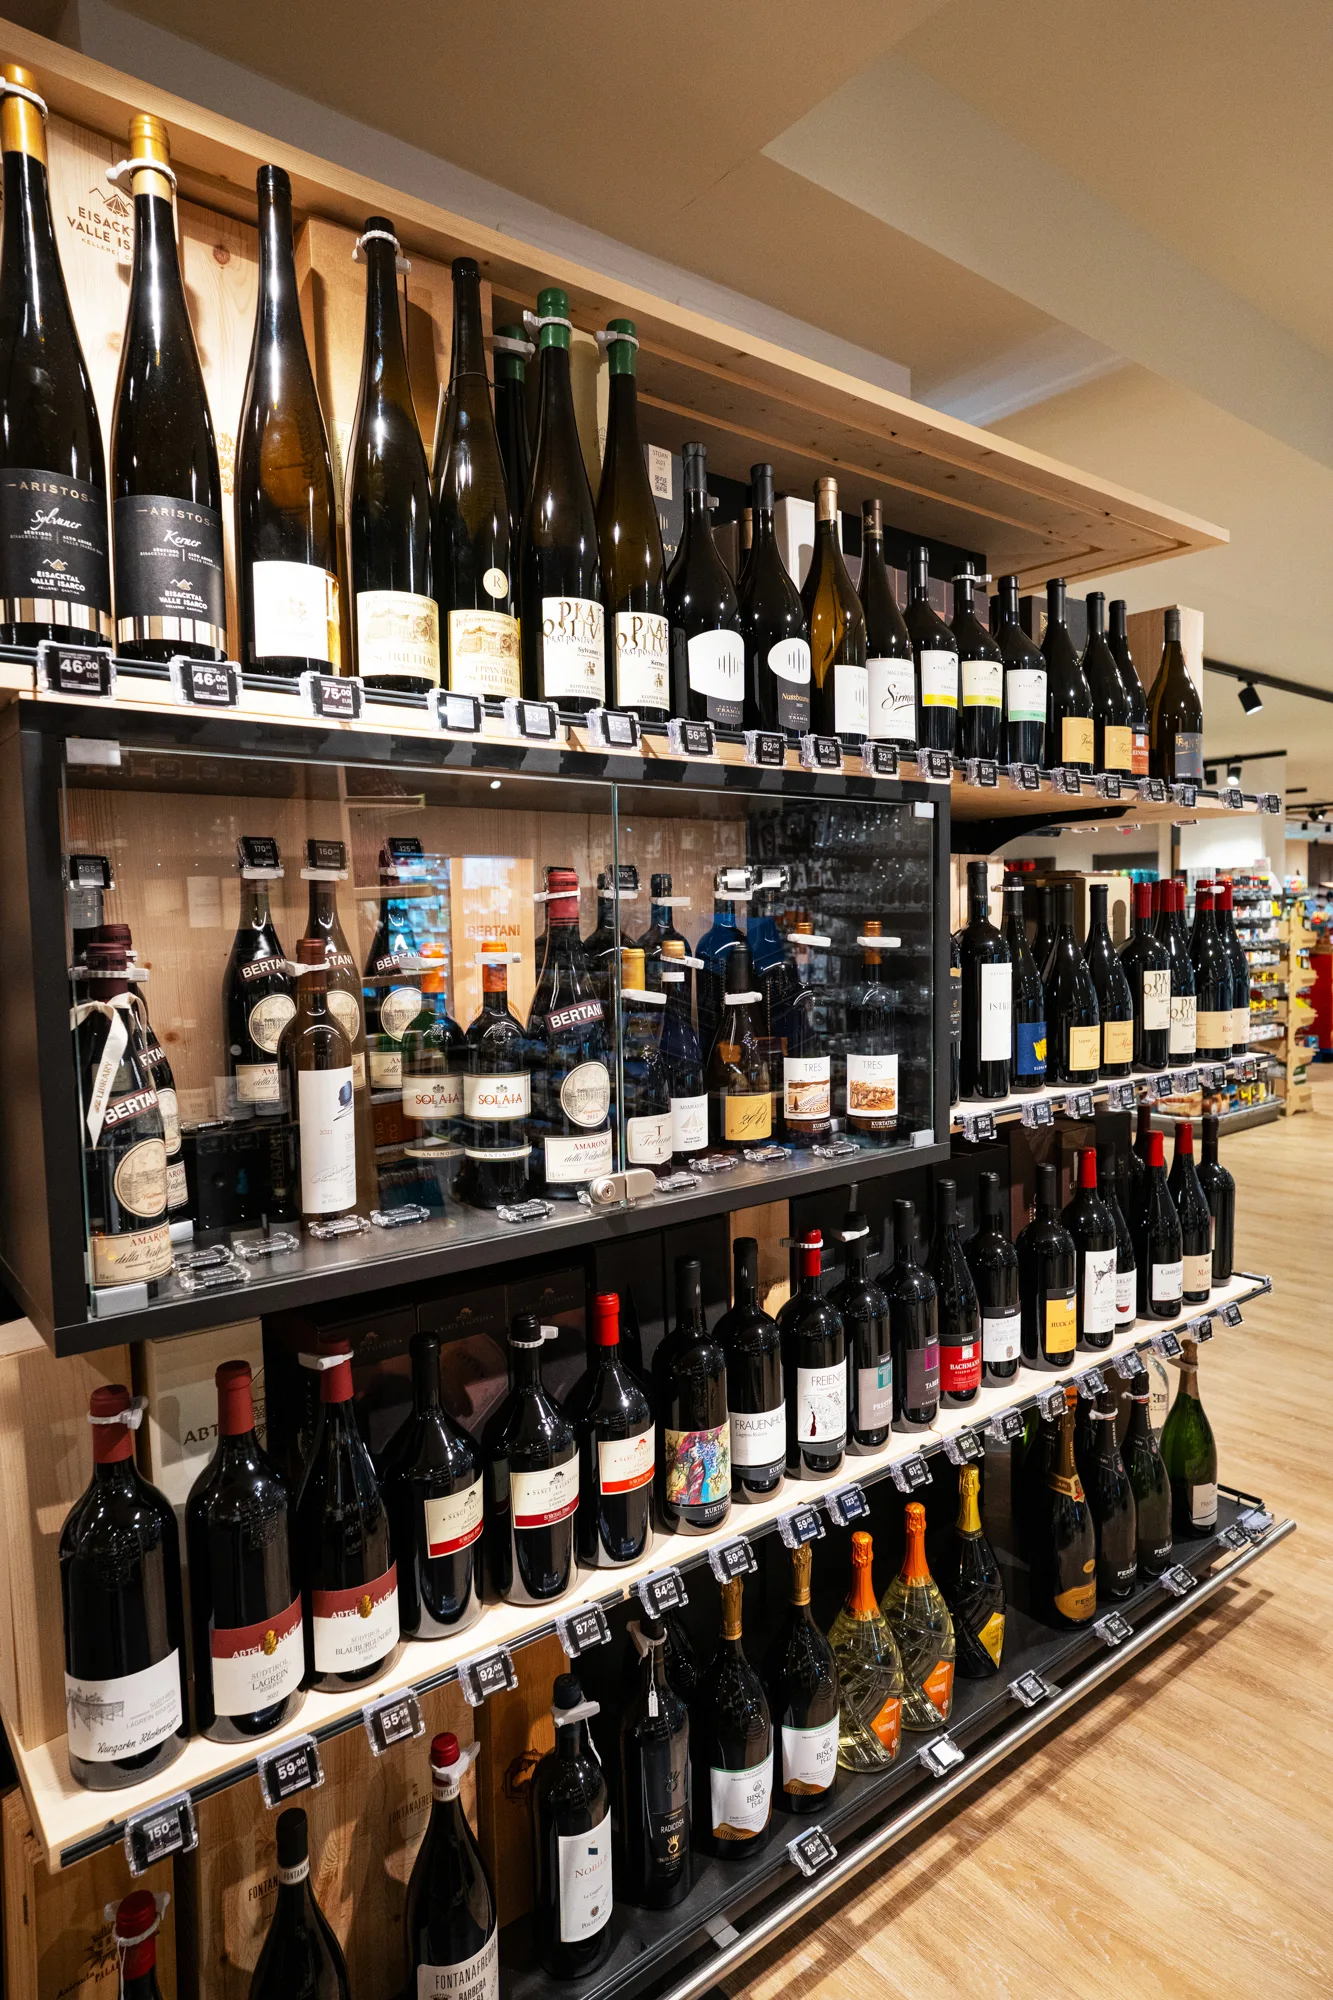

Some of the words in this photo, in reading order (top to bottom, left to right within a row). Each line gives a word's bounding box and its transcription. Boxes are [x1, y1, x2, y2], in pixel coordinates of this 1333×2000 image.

[78, 206, 135, 237] EISACK
[67, 216, 110, 243] VALLE
[117, 236, 131, 250] IS
[20, 481, 89, 502] ARISTOS
[150, 507, 210, 526] ARISTOS
[163, 529, 201, 548] Kerner
[30, 578, 54, 586] VALLE
[57, 580, 85, 591] ISARCO
[37, 570, 80, 583] EISACKTAL
[493, 575, 501, 588] R
[159, 596, 180, 605] VALLE
[183, 599, 208, 610] ISARCO
[165, 590, 203, 602] EISACKTAL
[578, 647, 599, 656] Sylvaner
[60, 659, 98, 673] 46,00
[193, 672, 227, 685] 46,00
[322, 686, 350, 700] 75,00
[466, 925, 521, 937] BERTANI
[242, 959, 286, 979] BERTA
[804, 1063, 823, 1072] TRES
[863, 1060, 883, 1070] TRES
[97, 1061, 113, 1099] LIBRARY
[104, 1090, 158, 1125] BERTAN
[415, 1093, 460, 1105] SOLAIA
[479, 1093, 522, 1105] SOLAIA
[573, 1139, 608, 1151] AMARONE
[130, 1228, 169, 1247] AMARON
[755, 1275, 787, 1289] TATSCH
[811, 1369, 845, 1387] FREIENF
[735, 1416, 784, 1430] FRAUENHÜ
[184, 1424, 219, 1446] ABT
[704, 1500, 730, 1516] KURTATS
[1117, 1563, 1137, 1577] FERRA
[654, 1582, 674, 1599] 84,00
[331, 1606, 358, 1620] ABTEI
[351, 1627, 380, 1644] SÜDTIROL
[575, 1618, 596, 1636] 87,00
[335, 1626, 393, 1656] BLAUBURGUNDER
[232, 1643, 261, 1659] ABTEI
[251, 1658, 289, 1681] SÜDTIROL
[480, 1662, 502, 1682] 92,00
[252, 1668, 289, 1691] LAGREIN
[126, 1711, 154, 1730] LAGREIN
[383, 1707, 409, 1730] 55,95
[816, 1745, 835, 1760] BISOL
[820, 1753, 832, 1765] 1542
[278, 1756, 307, 1780] 59,90
[747, 1787, 767, 1804] BISOL
[751, 1797, 764, 1809] 1542
[388, 1791, 433, 1825] FONTANAFRED
[148, 1817, 179, 1842] 150,00
[660, 1818, 685, 1834] RADICOSA
[283, 1860, 310, 1881] FONTANA
[248, 1873, 278, 1901] FONTAN
[435, 1937, 498, 1991] FONTANAFREDDA
